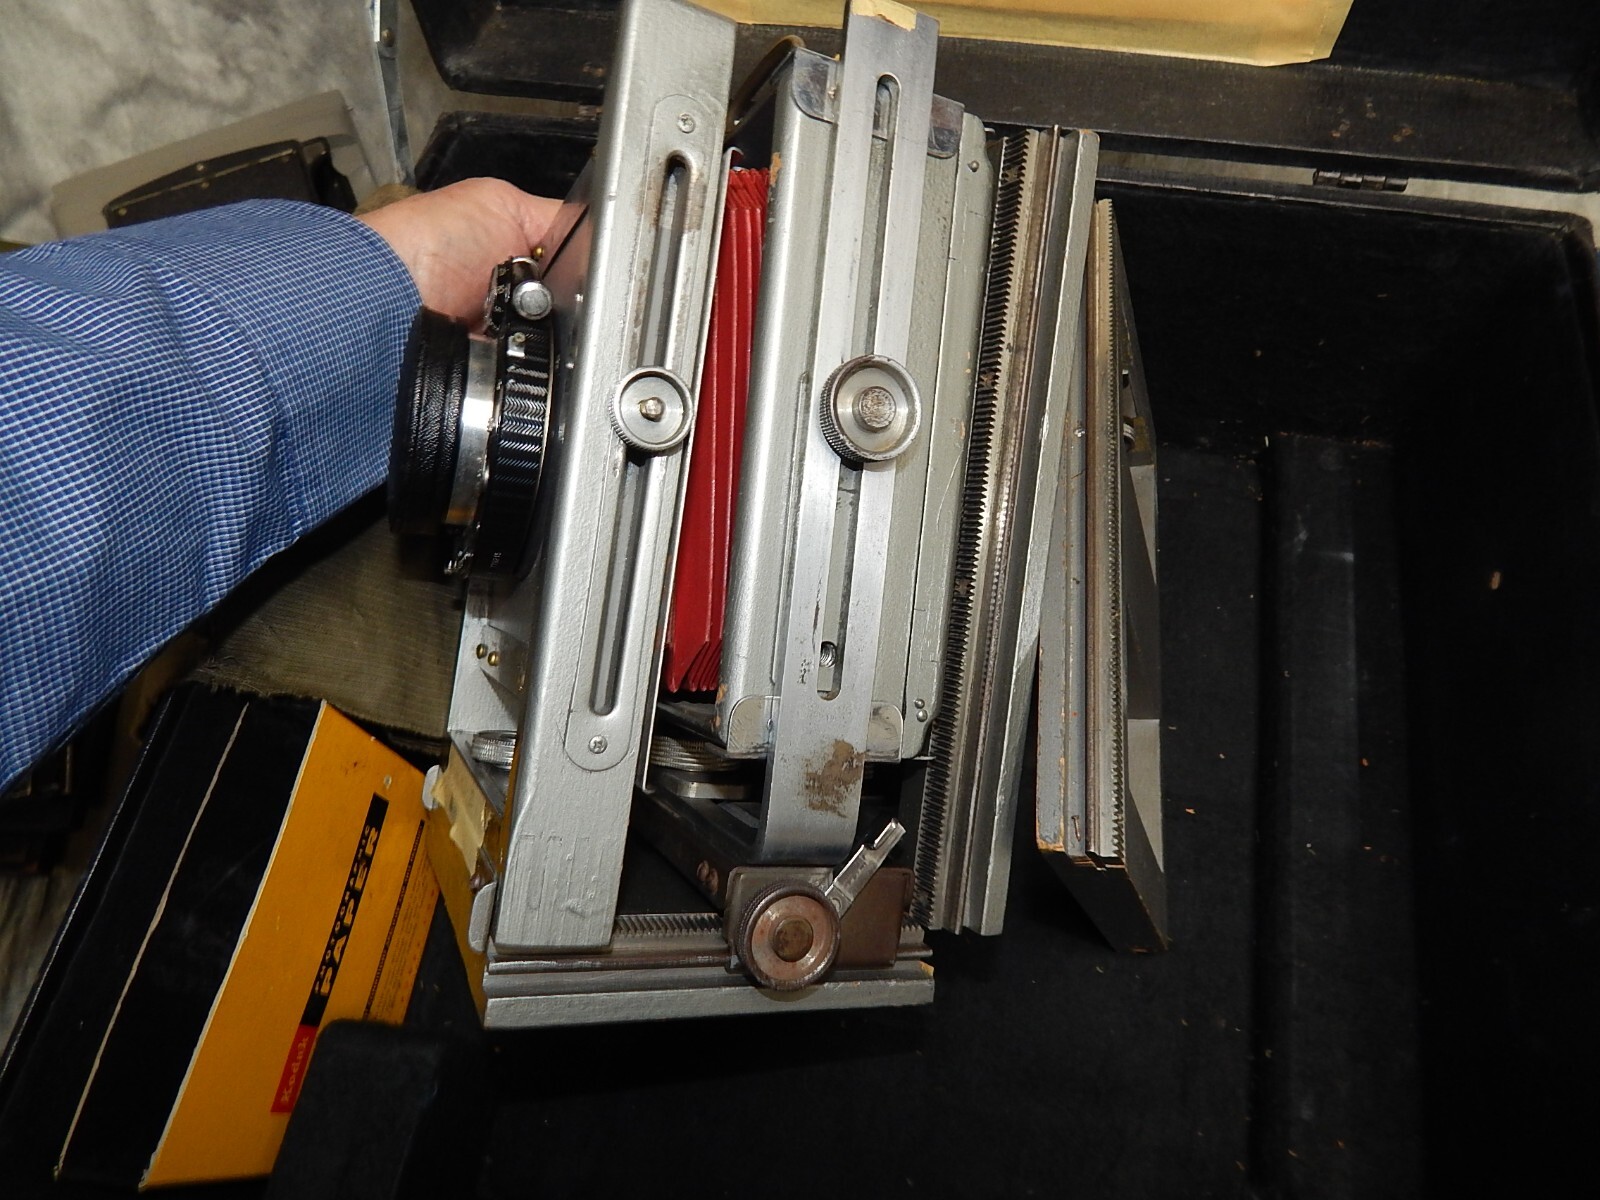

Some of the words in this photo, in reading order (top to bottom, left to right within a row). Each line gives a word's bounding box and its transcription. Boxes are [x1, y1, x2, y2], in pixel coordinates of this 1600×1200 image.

[314, 826, 370, 994] PHOTOGRAPHIC
[320, 827, 378, 996] PAPER
[282, 1037, 308, 1102] Kodak
